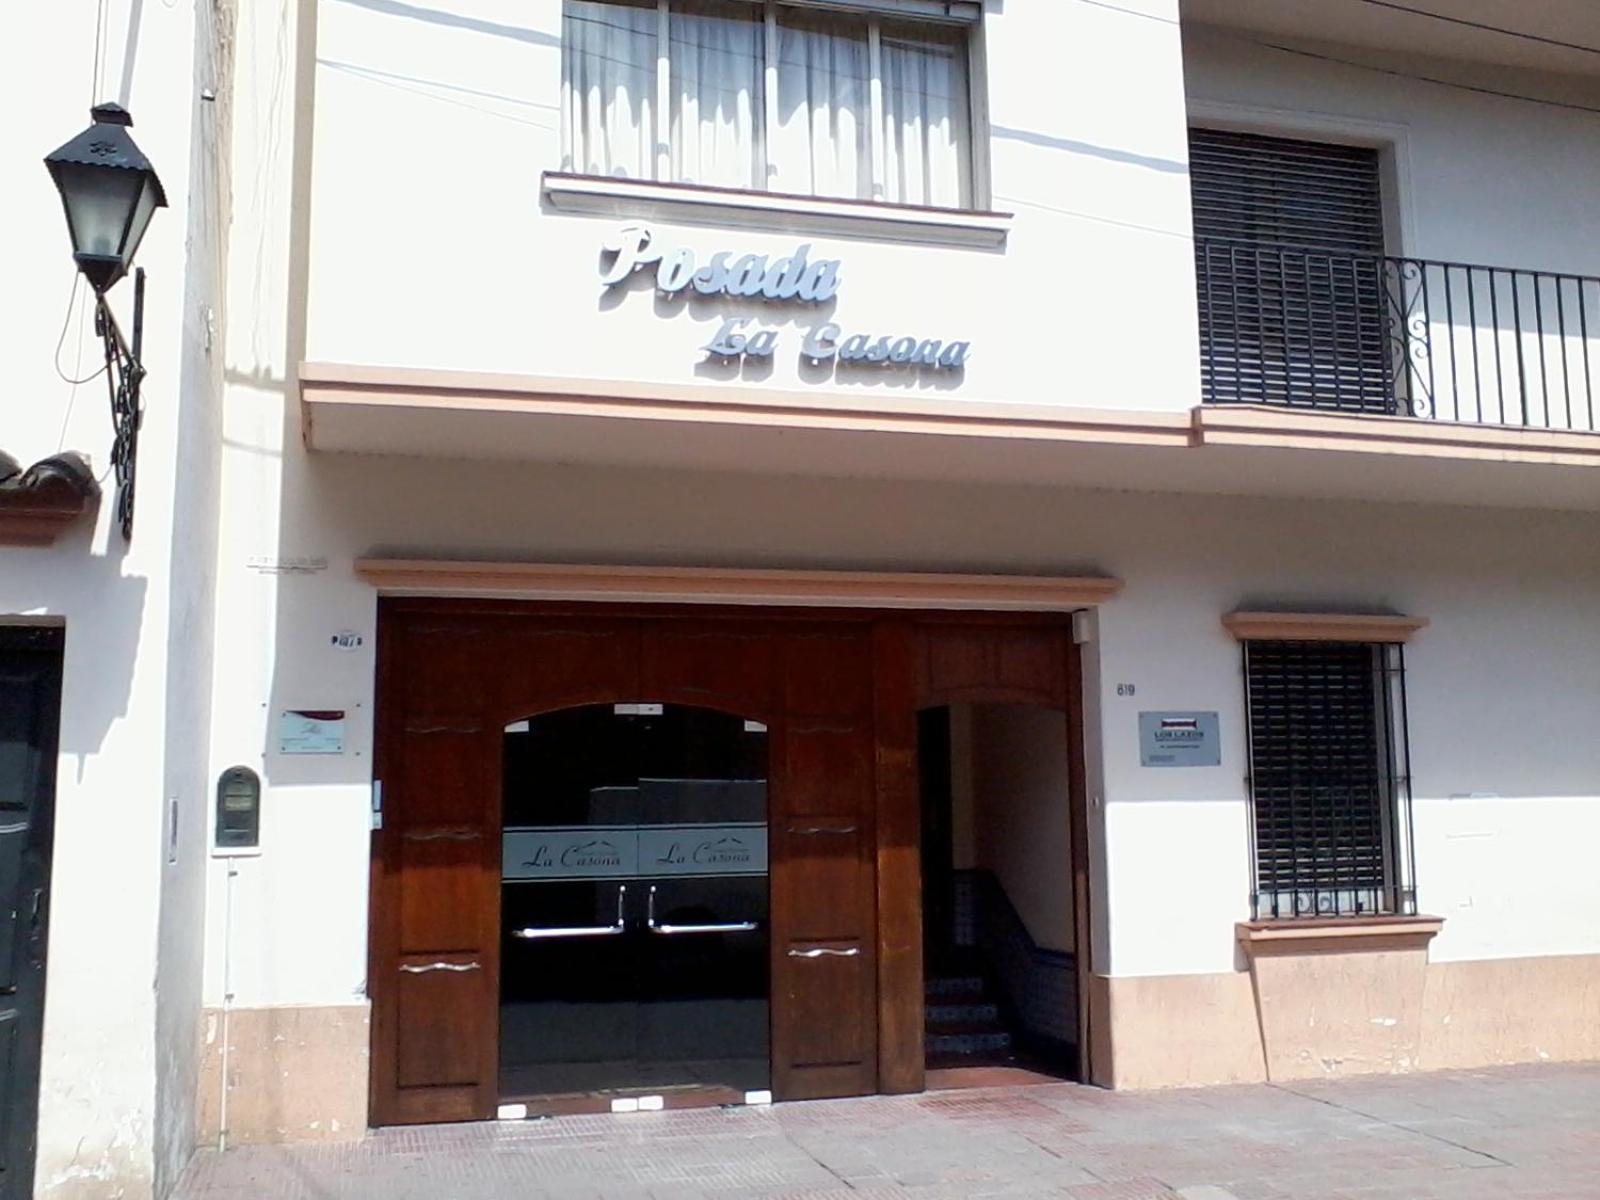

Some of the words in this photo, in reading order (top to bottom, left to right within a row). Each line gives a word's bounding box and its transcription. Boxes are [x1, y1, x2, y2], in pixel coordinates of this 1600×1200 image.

[600, 227, 842, 301] Posada
[701, 317, 778, 357] La
[801, 321, 971, 367] Casona
[521, 845, 553, 867] La
[561, 846, 621, 868] Casona
[655, 842, 686, 864] La
[693, 841, 750, 864] Casona
